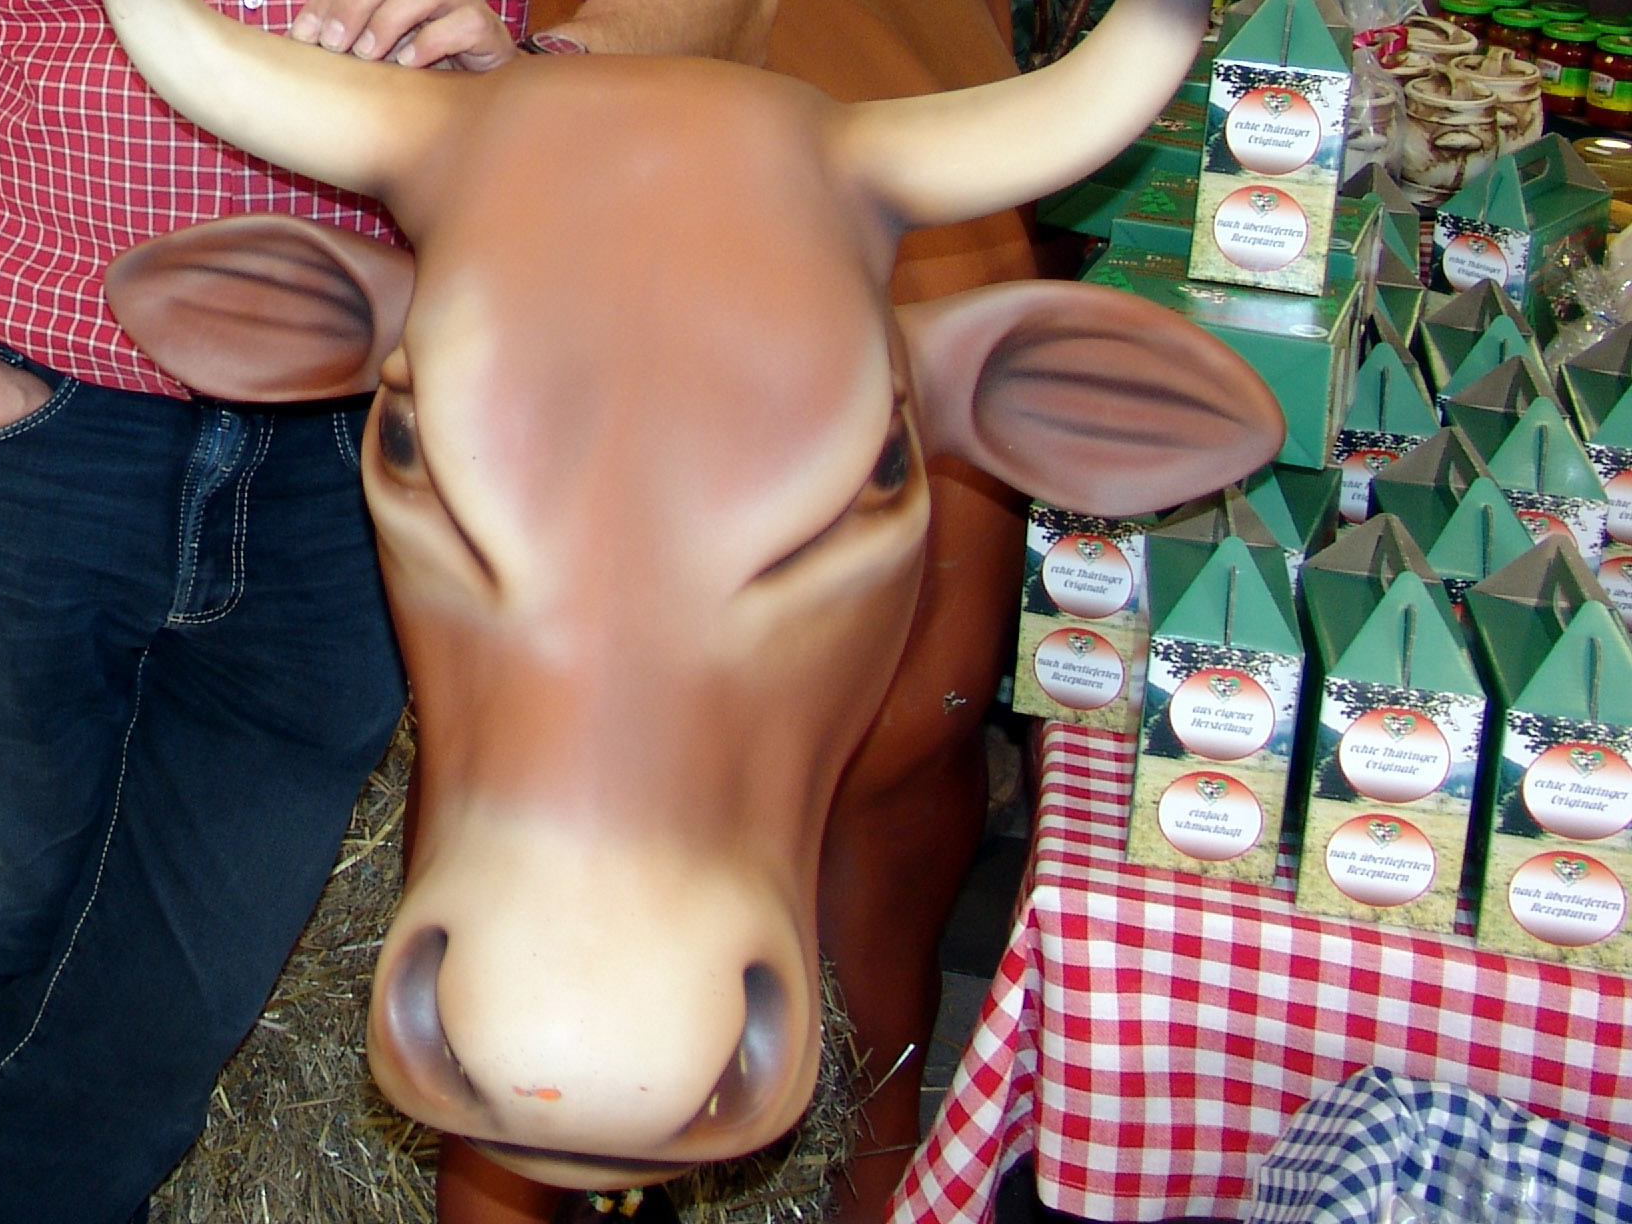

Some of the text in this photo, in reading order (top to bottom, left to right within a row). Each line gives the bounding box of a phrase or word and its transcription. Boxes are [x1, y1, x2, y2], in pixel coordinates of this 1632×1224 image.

[1262, 122, 1311, 138] Thüringer
[1077, 568, 1124, 585] Thüringer
[1192, 705, 1254, 722] aus eigener
[1190, 717, 1254, 736] Herstellung
[1349, 744, 1438, 764] echte Thüringer
[1365, 759, 1420, 776] Originale
[1534, 778, 1630, 801] echte Thüringer
[1551, 794, 1609, 812] Originale
[1189, 809, 1230, 823] einfach
[1329, 848, 1357, 862] nach
[1346, 864, 1410, 883] Rezepturen
[1512, 885, 1542, 899] nach
[1530, 902, 1598, 923] Rezepturen
